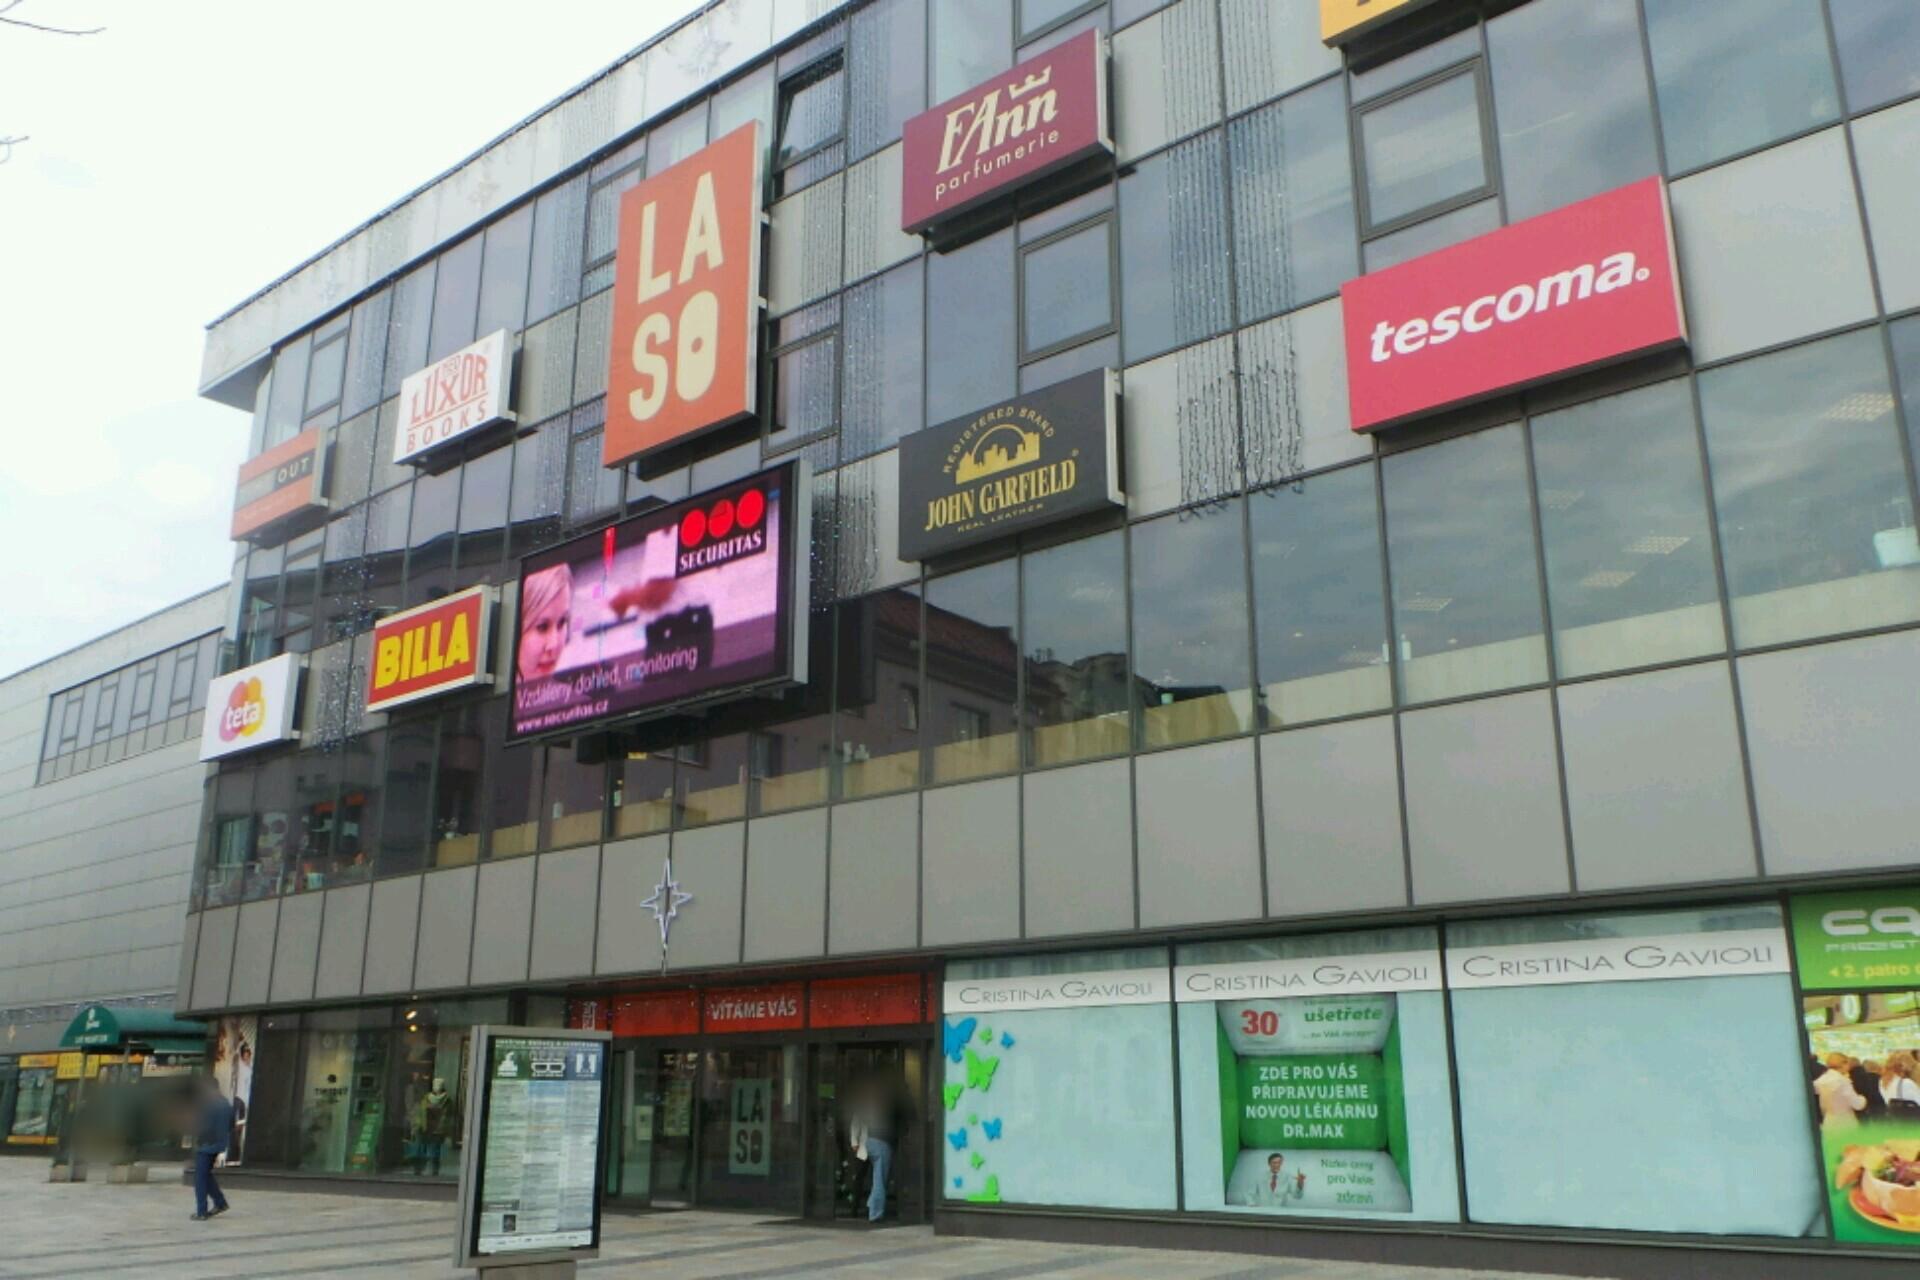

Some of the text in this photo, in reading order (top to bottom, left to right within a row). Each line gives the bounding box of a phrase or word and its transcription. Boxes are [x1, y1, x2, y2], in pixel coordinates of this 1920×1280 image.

[936, 130, 1060, 200] parfumerie
[638, 171, 724, 304] LA
[410, 353, 488, 425] LUXOR
[406, 400, 487, 453] BOOKS
[943, 405, 1055, 473] REGISTERED BRAND
[278, 457, 309, 483] OUT
[924, 458, 1076, 532] JOHN GARFIELD
[958, 502, 1043, 532] REAL LEATHER
[680, 529, 762, 572] SECURITAS
[375, 612, 469, 689] BILLA
[625, 646, 698, 684] monitoring
[225, 699, 260, 731] teta
[1863, 962, 1910, 981] patro
[768, 999, 797, 1018] VÁS
[1304, 1007, 1383, 1023] ušetřete
[1260, 1062, 1358, 1080] ZDE PRO VÁS
[1252, 1083, 1369, 1099] PŘIPRAVUJEME
[1246, 1101, 1378, 1119] NOVOU LÉKÁRNU
[1283, 1123, 1344, 1138] DR.MAX
